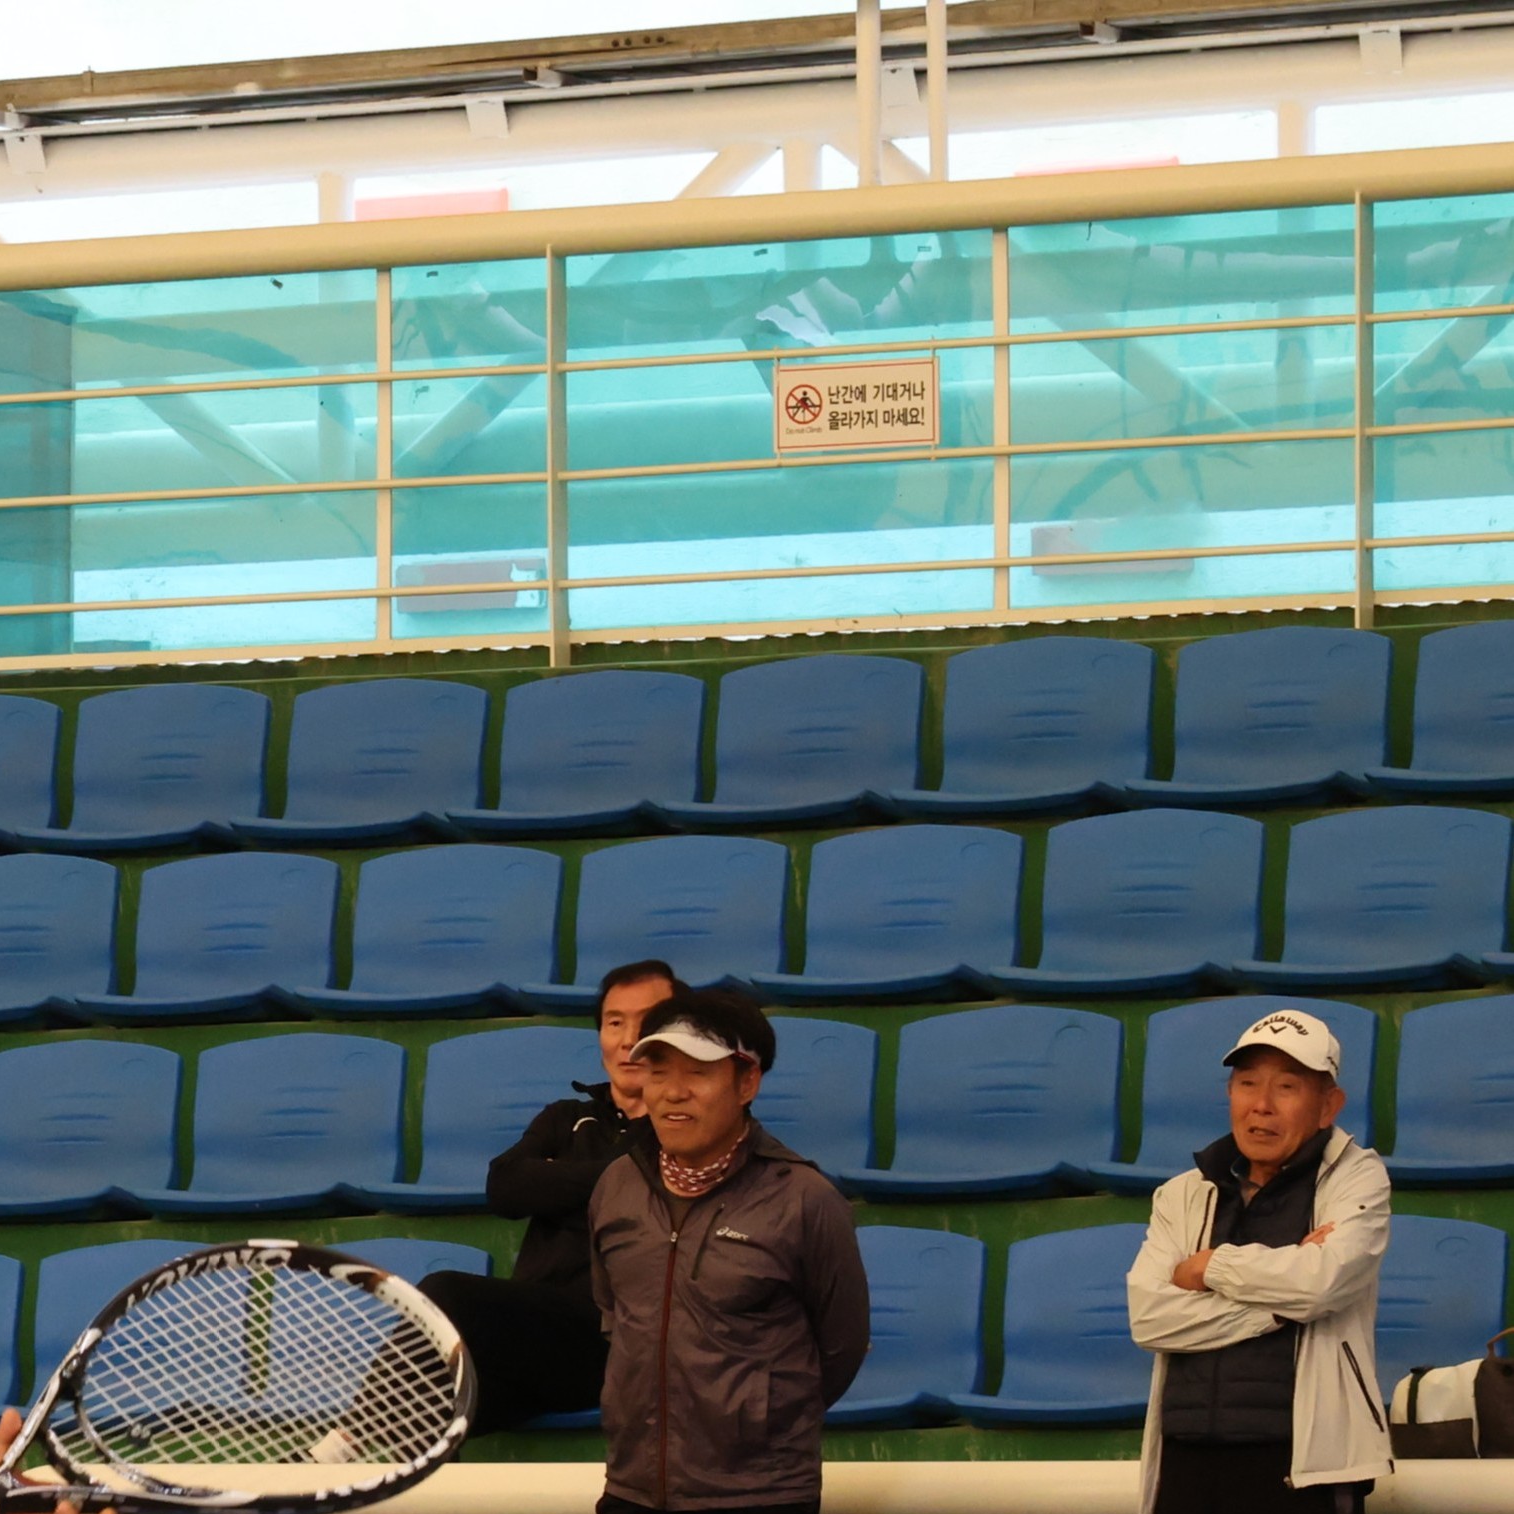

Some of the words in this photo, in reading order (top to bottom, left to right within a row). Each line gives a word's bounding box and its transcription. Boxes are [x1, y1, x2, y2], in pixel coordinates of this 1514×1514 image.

[828, 384, 867, 405] 난간에
[873, 381, 926, 403] 기대거나
[828, 408, 878, 431] 올라가지
[883, 407, 925, 427] 마세요!
[1252, 1015, 1309, 1036] Callaway
